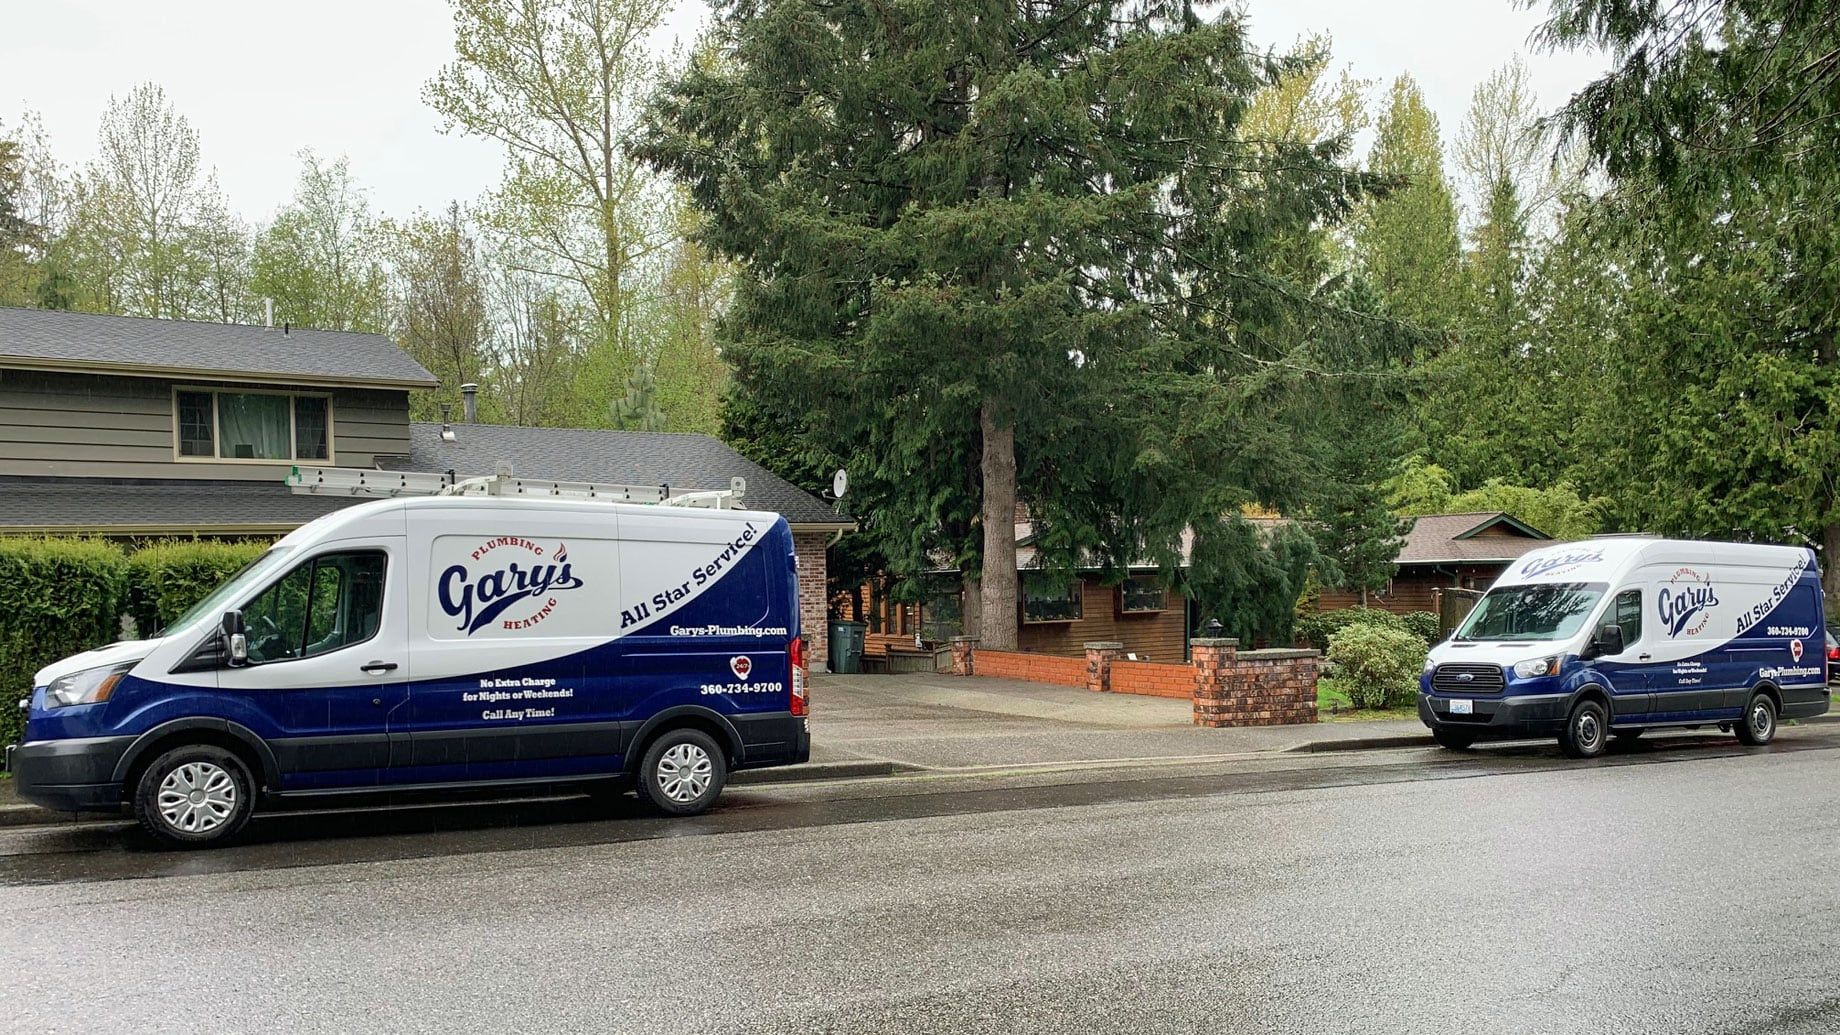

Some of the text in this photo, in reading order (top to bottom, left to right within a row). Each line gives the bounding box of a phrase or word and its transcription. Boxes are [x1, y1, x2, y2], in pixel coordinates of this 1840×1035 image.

[471, 537, 544, 560] PLUMBING
[620, 522, 757, 628] All Star Service!
[1736, 553, 1806, 633] All Star Service!
[503, 597, 557, 629] HEATING
[670, 625, 787, 637] Garys-Plumbing.com
[480, 678, 556, 688] No Extra Charge
[700, 682, 782, 694] 360-734-9700
[462, 692, 478, 701] for
[479, 691, 511, 702] Nights
[523, 688, 574, 698] Weekends!
[482, 707, 555, 720] Call Any Time!
